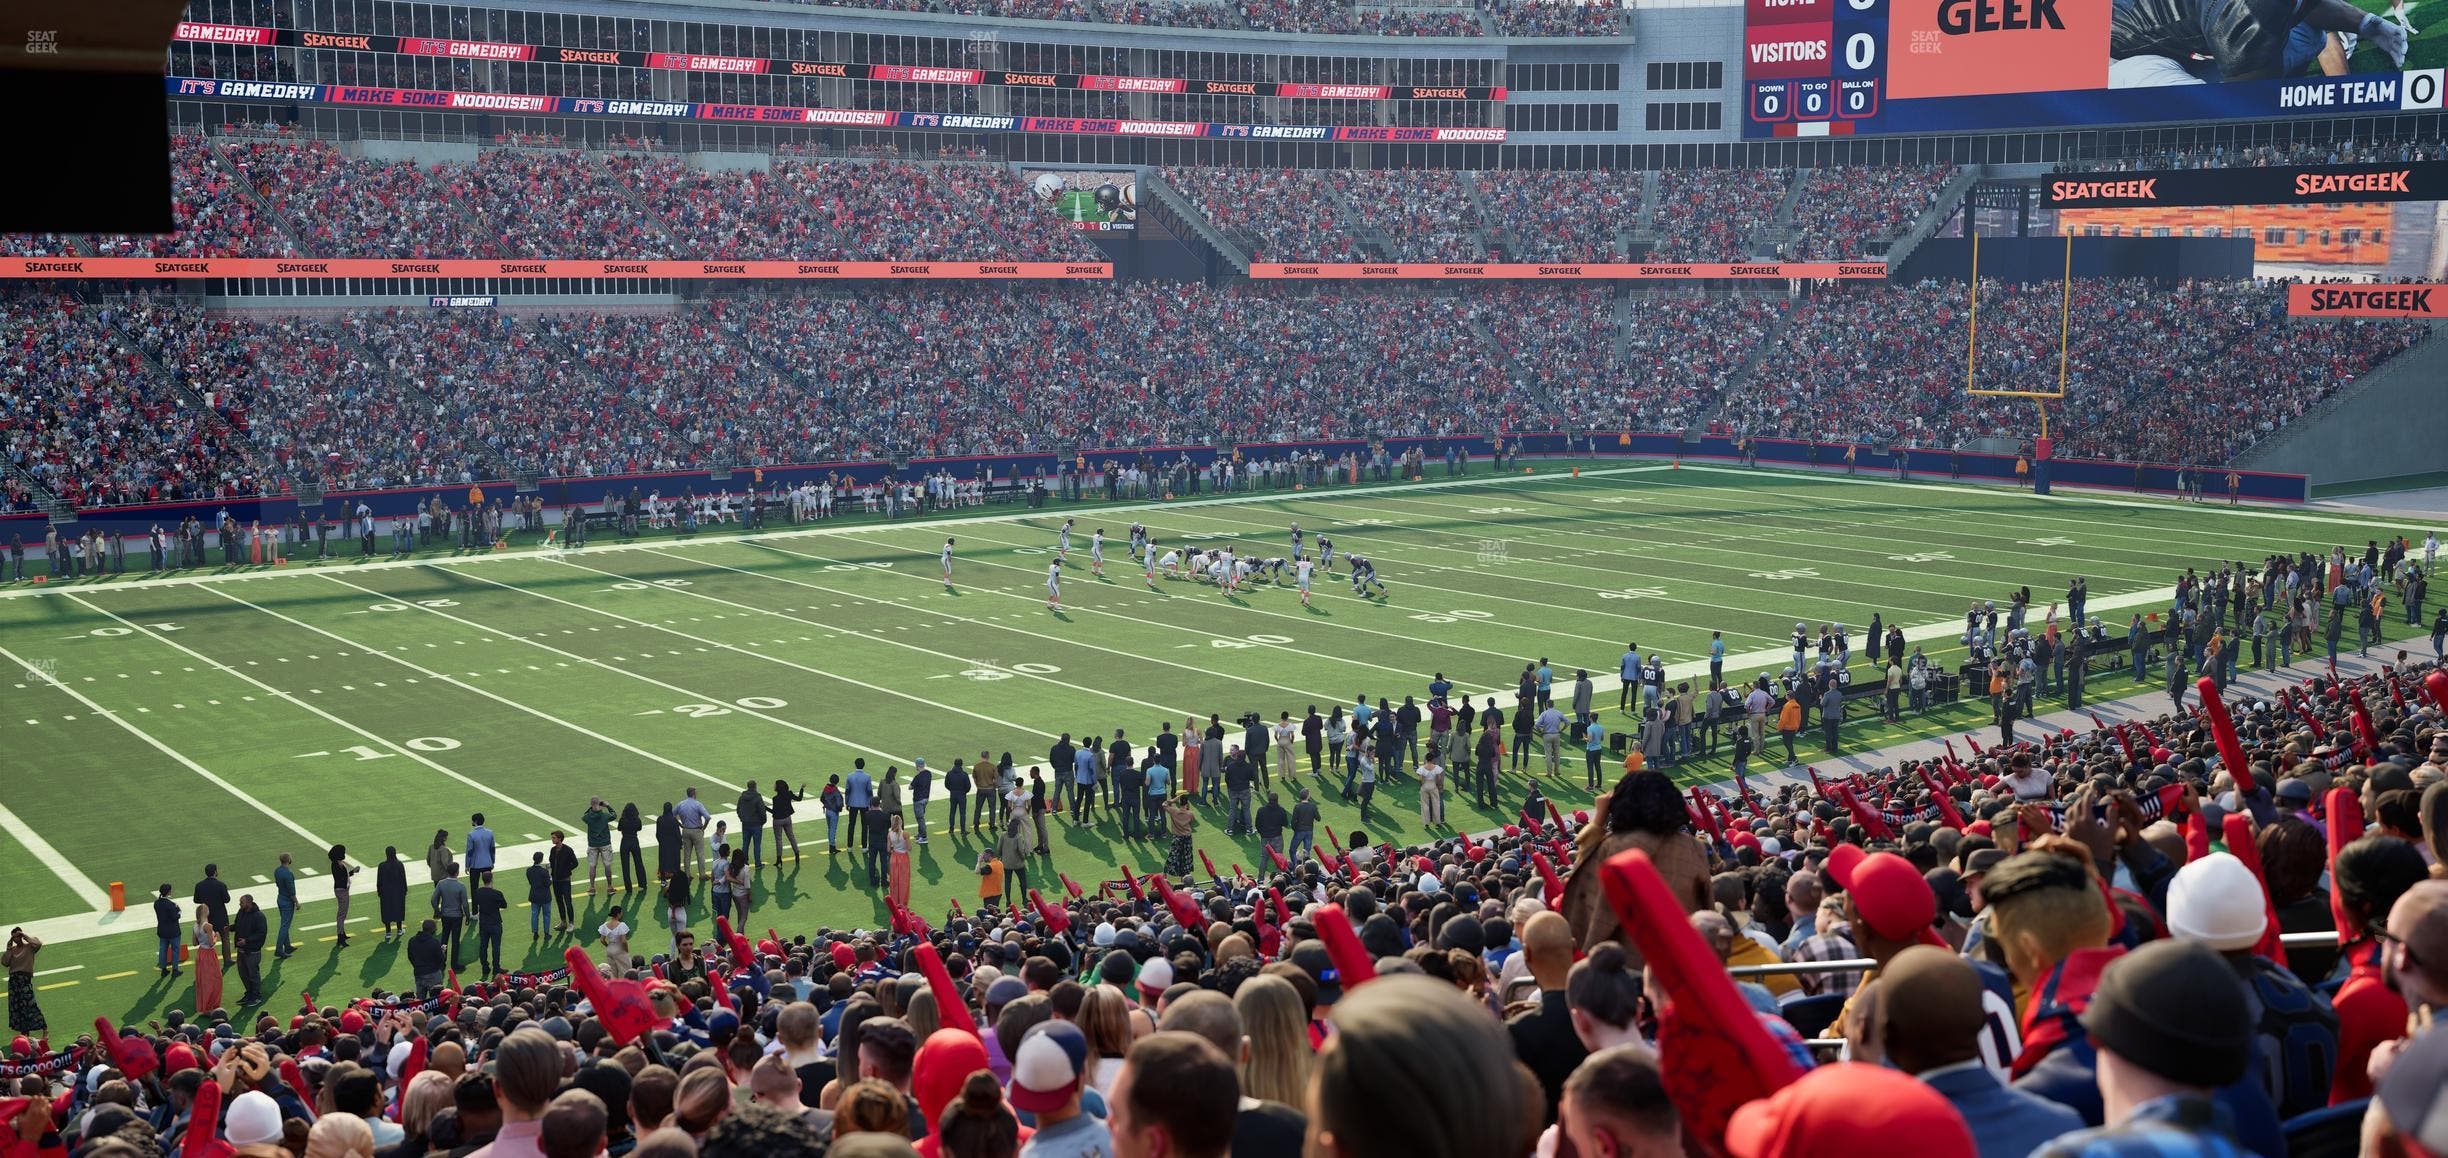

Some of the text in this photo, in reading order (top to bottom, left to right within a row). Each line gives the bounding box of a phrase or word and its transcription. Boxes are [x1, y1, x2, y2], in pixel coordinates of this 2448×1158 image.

[1938, 0, 2065, 35] GEEK
[179, 24, 260, 43] GAMEDAY!
[303, 32, 371, 50] SEATGEEK
[419, 41, 521, 58] IT'S GAMEDAY!
[1750, 40, 1827, 63] VISITORS
[1845, 32, 1875, 70] 0
[560, 49, 620, 64] SEATGEEK
[664, 55, 757, 71] IT'S GAMEDAY!
[791, 62, 846, 77] SEATGEEK
[886, 67, 972, 82] IT'S GAMEDAY!
[1005, 73, 1056, 86] SEATGEEK
[1094, 77, 1175, 91] IT'S GAMEDAY!
[1842, 80, 1874, 89] BALL ON
[179, 79, 315, 100] IT'S GAMEDAY!
[1206, 82, 1255, 95] SEATGEEK
[1296, 85, 1380, 98] IT'S GAMEDAY!
[1412, 87, 1467, 99] SEATGEEK
[1759, 84, 1784, 93] DOWN
[1801, 82, 1828, 91] TO GO
[2410, 73, 2436, 104] 0
[342, 89, 393, 103] MAKE
[402, 92, 449, 105] SOME
[2280, 80, 2396, 107] HOME TEAM
[1763, 95, 1779, 114] 0
[1806, 93, 1822, 112] 0
[1849, 91, 1865, 110] 0
[573, 99, 688, 117] IT'S GAMEDAY!
[711, 106, 755, 118] MAKE
[762, 108, 803, 121] SOME
[912, 114, 1014, 129] IT'S GAMEDAY!
[1034, 119, 1075, 131] MAKE
[1080, 120, 1116, 132] SOME
[1221, 125, 1325, 139] IT'S GAMEDAY!
[1346, 128, 1388, 139] MAKE
[1394, 128, 1434, 140] SOME
[2052, 178, 2157, 201] SEATGEEK
[2294, 170, 2411, 196] SEATGEEK
[25, 262, 83, 273] SEATGEEK
[155, 262, 209, 273] SEATGEEK
[277, 263, 328, 273] SEATGEEK
[391, 263, 440, 273] SEATGEEK
[500, 264, 547, 273] SEATGEEK
[603, 264, 648, 274] SEATGEEK
[703, 265, 746, 274] SEATGEEK
[798, 265, 839, 274] SEATGEEK
[890, 265, 930, 274] SEATGEEK
[979, 265, 1018, 275] SEATGEEK
[1066, 265, 1103, 275] SEATGEEK
[1283, 266, 1319, 275] SEATGEEK
[1362, 266, 1398, 275] SEATGEEK
[1444, 266, 1484, 275] SEATGEEK
[1538, 266, 1581, 275] SEATGEEK
[1640, 266, 1691, 275] SEATGEEK
[1730, 266, 1780, 275] SEATGEEK
[1838, 266, 1885, 275] SEATGEEK
[449, 297, 493, 307] GAMEDAY!
[2310, 288, 2432, 314] SEATGEEK
[1839, 673, 1849, 684] 00
[510, 975, 528, 985] LET'S
[15, 1052, 72, 1075] GOOOOO!!!
